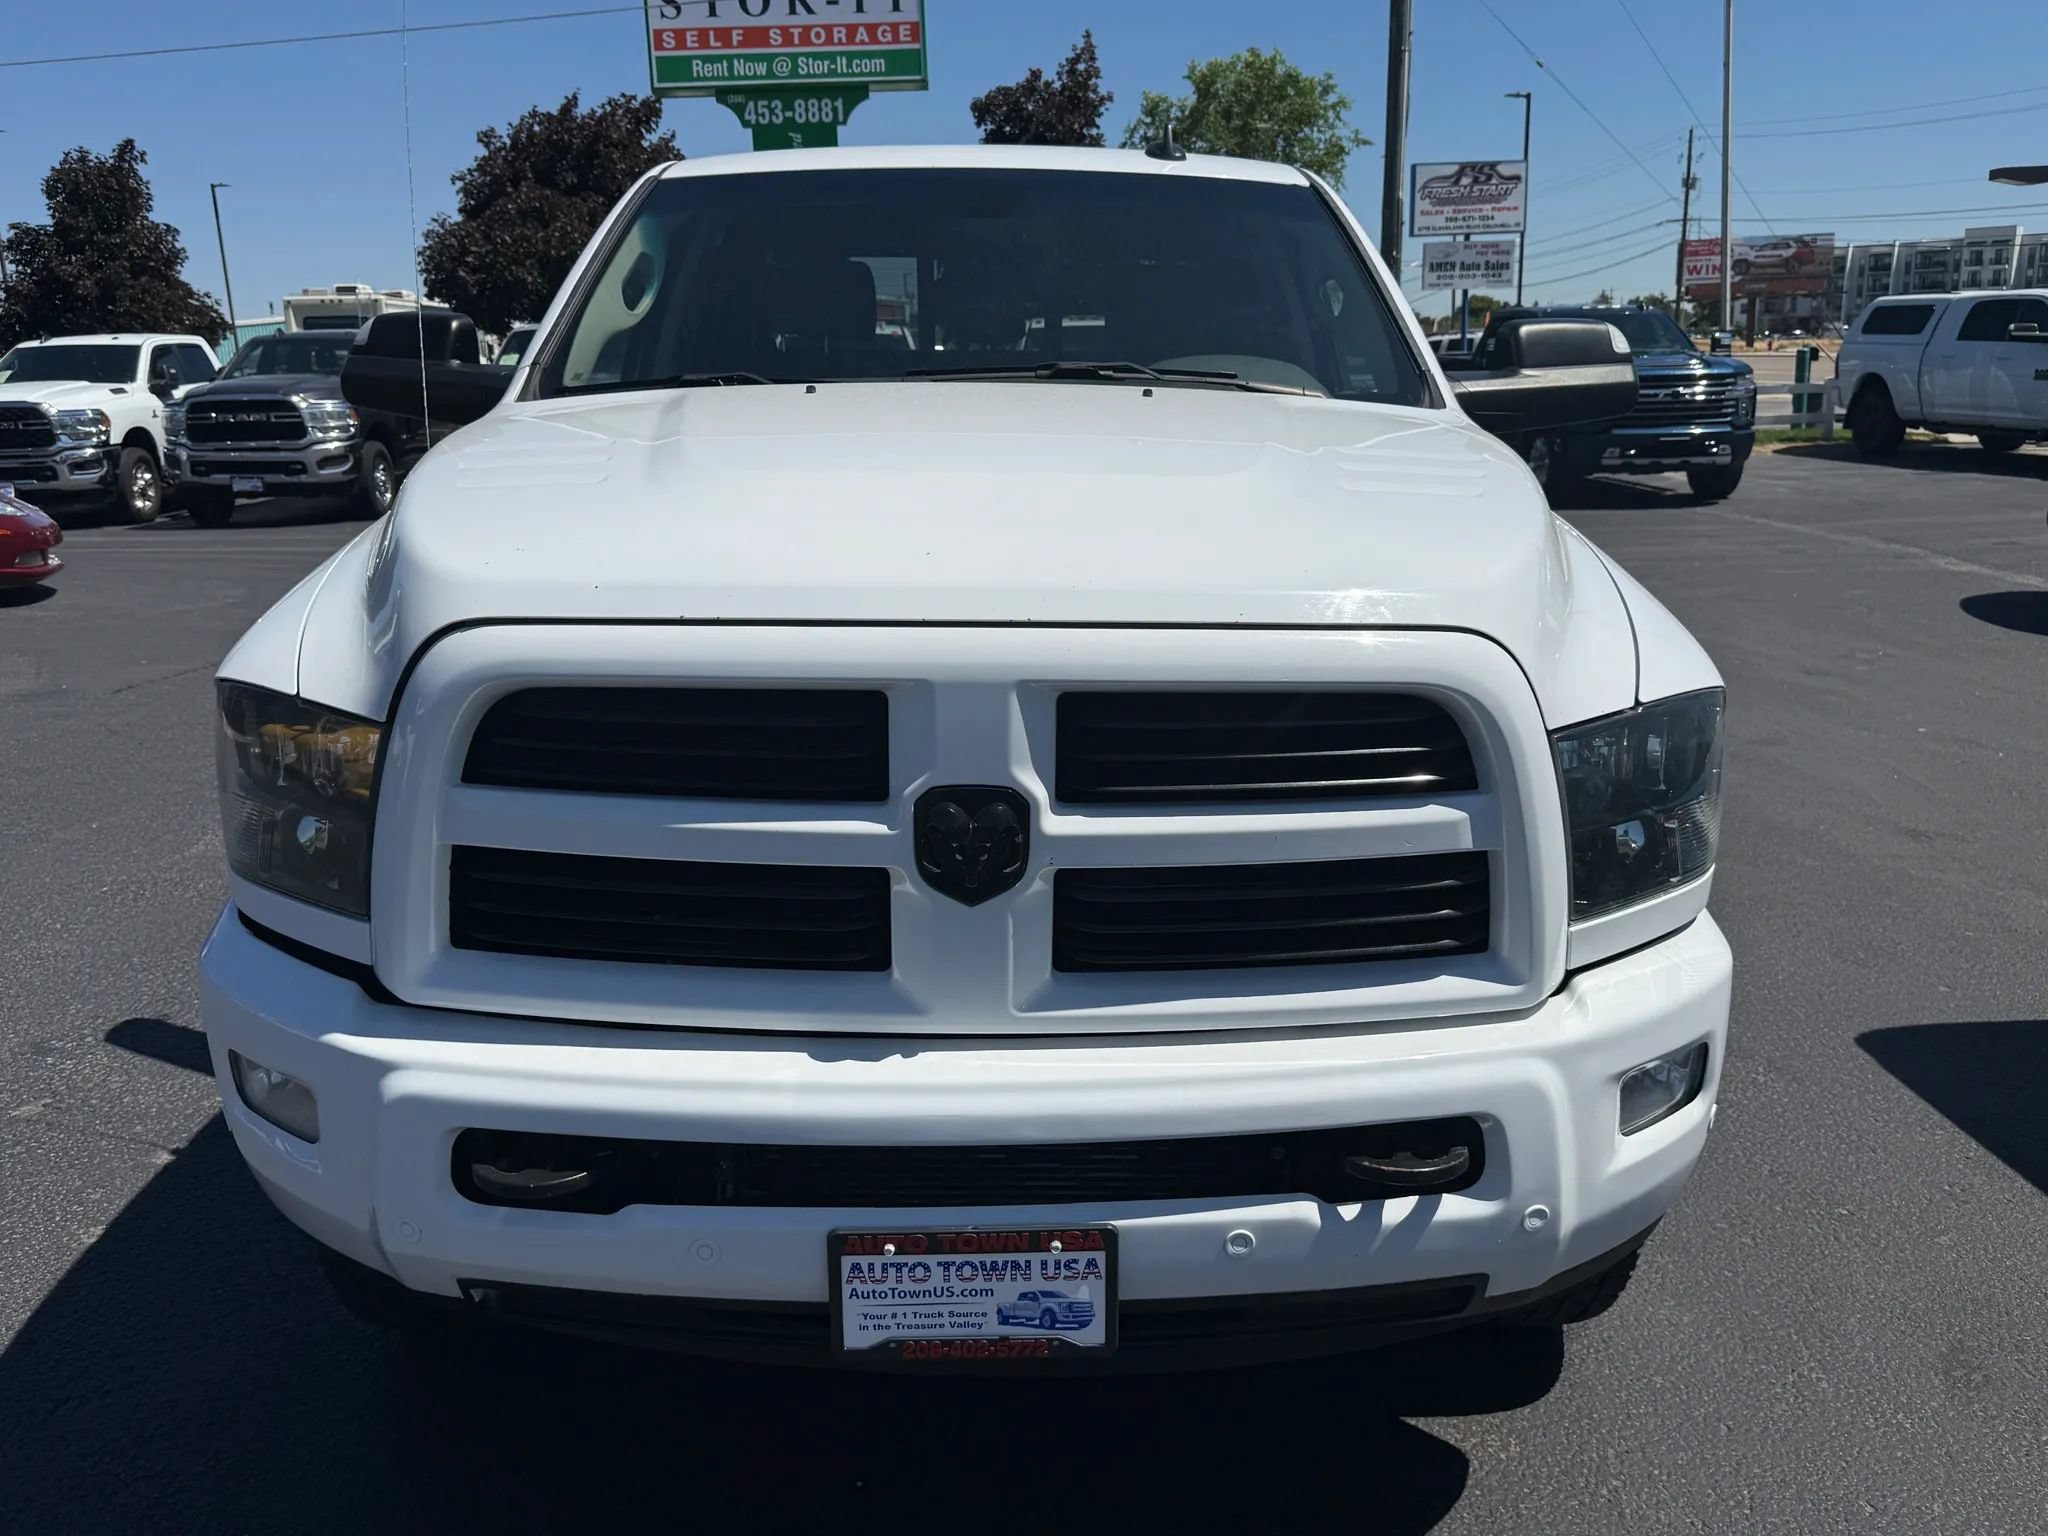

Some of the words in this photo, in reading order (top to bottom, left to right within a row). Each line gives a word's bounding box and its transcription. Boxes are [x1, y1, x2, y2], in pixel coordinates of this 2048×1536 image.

[662, 29, 744, 49] SELF
[768, 24, 914, 45] STORAGE
[692, 59, 728, 78] Rent
[733, 58, 767, 76] Now
[772, 57, 791, 77] @
[798, 56, 885, 75] Stor-It.com
[744, 97, 844, 125] 453-8881
[1421, 186, 1470, 200] FRESH
[1471, 184, 1517, 197] START
[1459, 261, 1481, 271] Auto
[1484, 260, 1510, 271] Sales
[1687, 263, 1723, 276] WIN
[844, 1234, 928, 1254] AUTO
[937, 1232, 1030, 1252] TOWN
[1040, 1230, 1104, 1251] USA
[845, 1261, 932, 1285] AUTO
[937, 1259, 1033, 1283] TOWN
[1040, 1257, 1103, 1281] USA
[849, 1286, 994, 1300] AutoTownUS.com
[912, 1310, 945, 1319] Truck
[947, 1310, 988, 1319] Source
[859, 1322, 869, 1331] in
[872, 1322, 892, 1331] the
[894, 1321, 946, 1330] Treasure
[902, 1339, 1049, 1360] 208-402-5772
